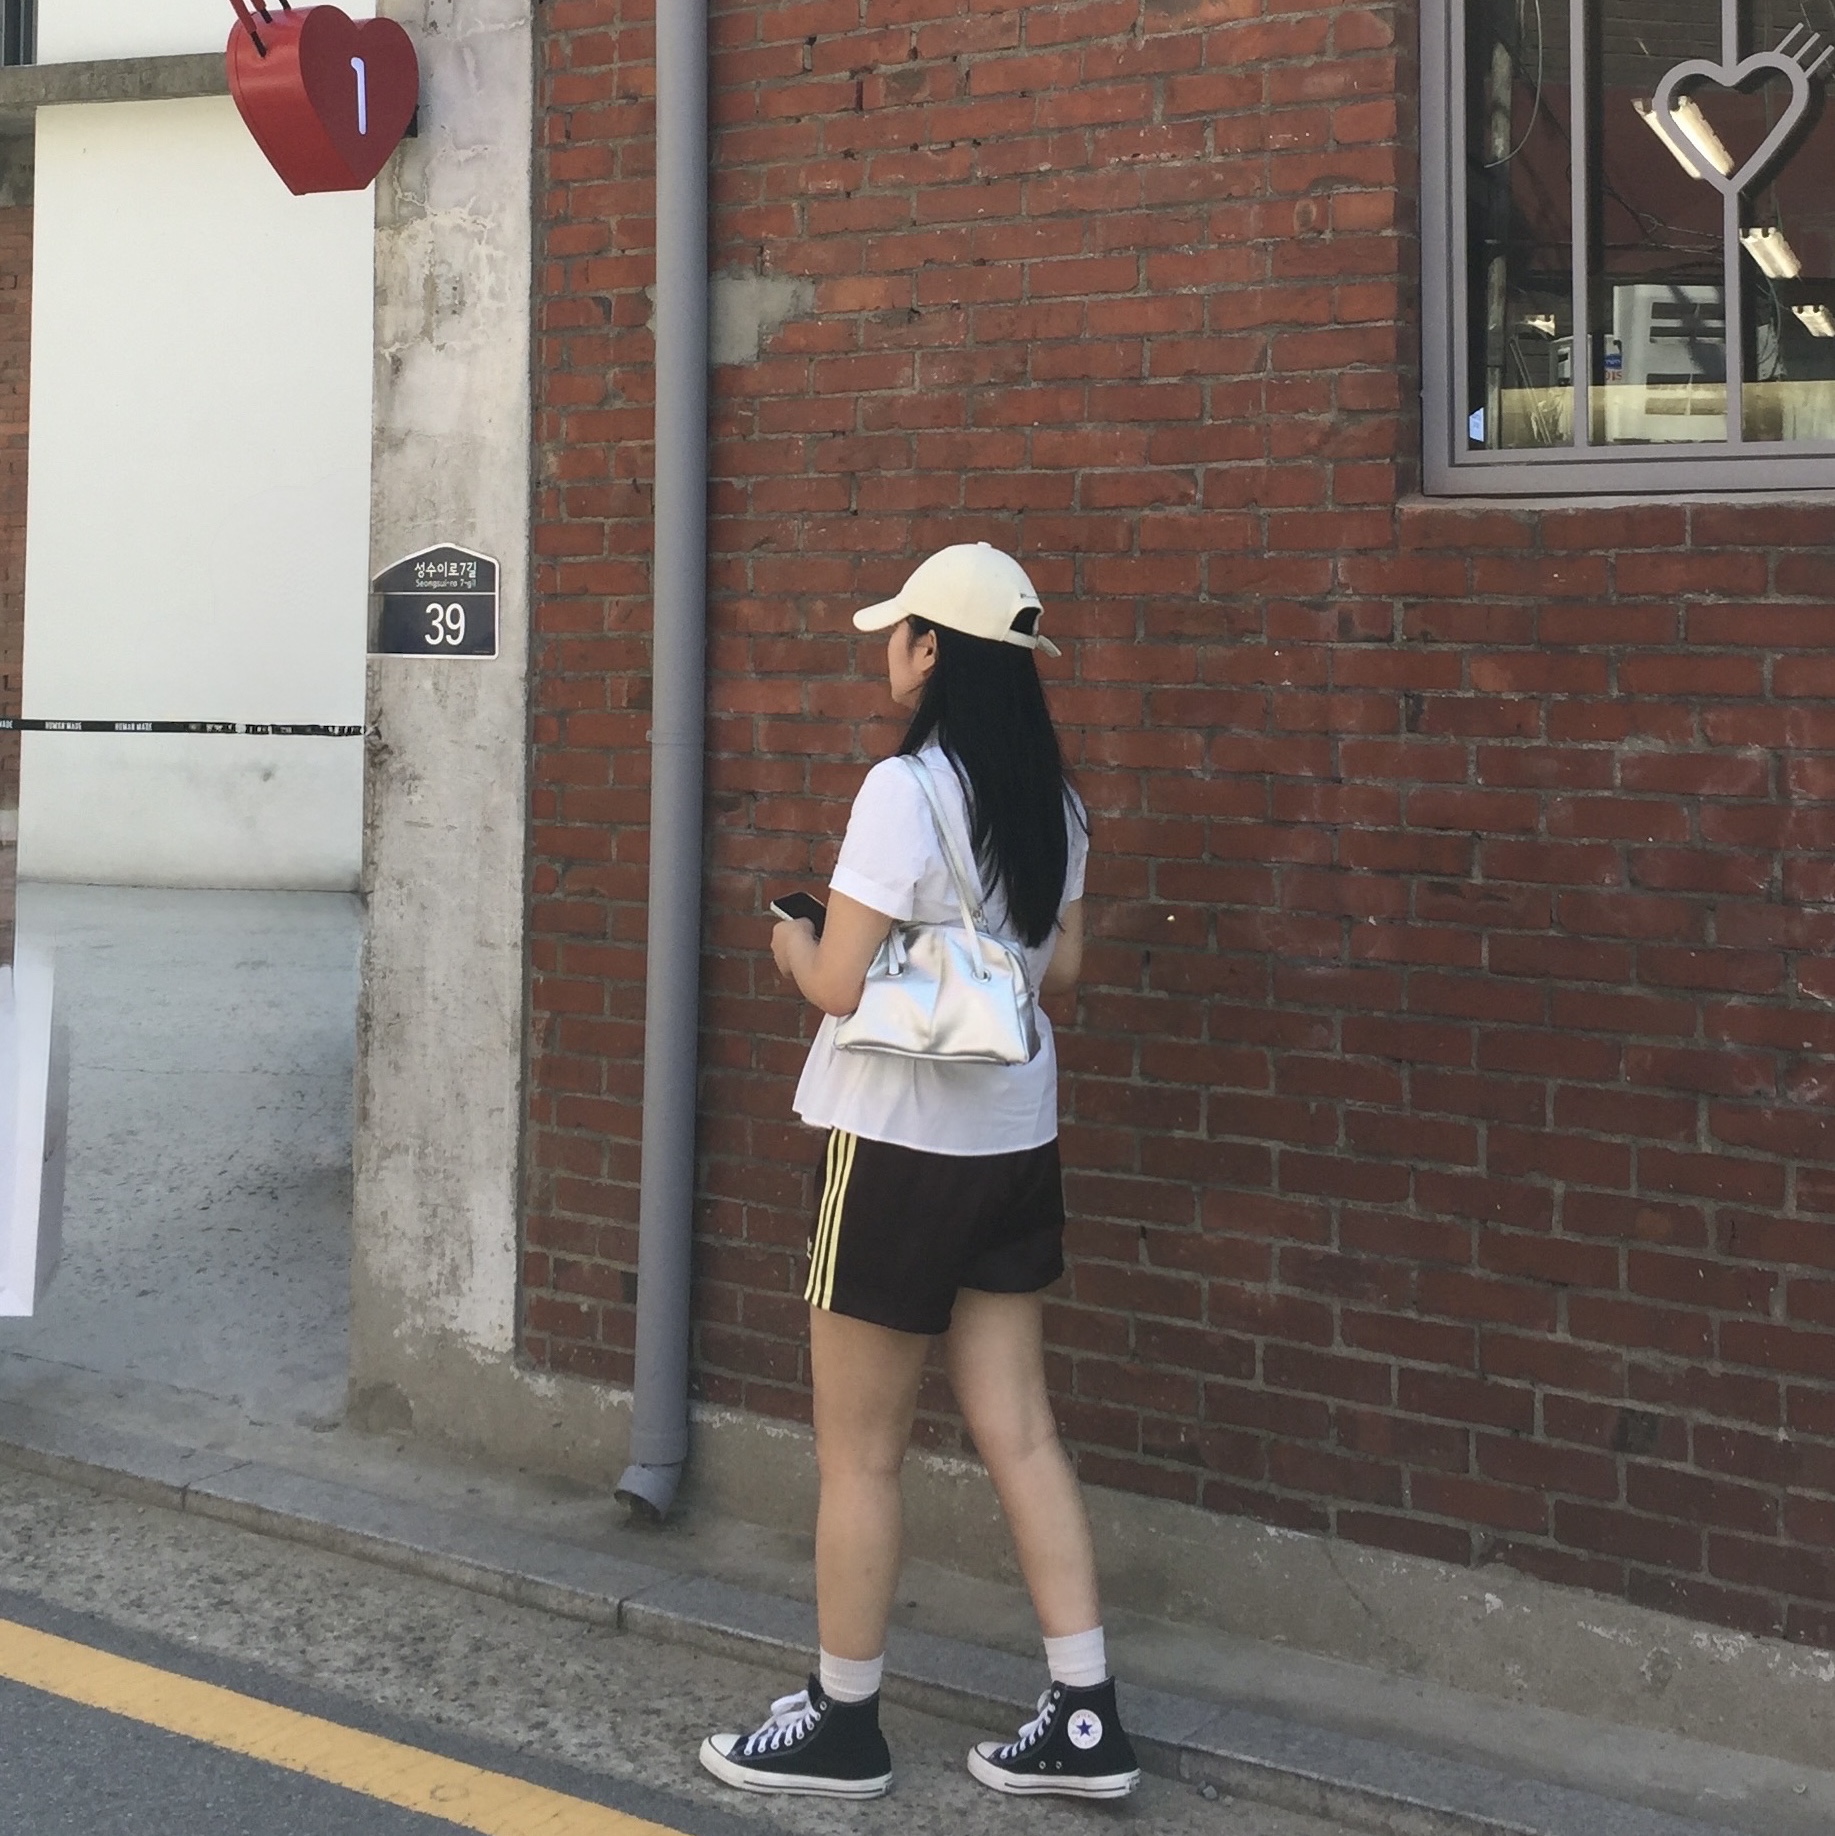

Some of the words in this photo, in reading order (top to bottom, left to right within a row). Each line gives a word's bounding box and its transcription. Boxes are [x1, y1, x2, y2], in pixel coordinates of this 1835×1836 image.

[350, 56, 367, 135] 1
[414, 561, 477, 578] 성수이로7길
[415, 578, 458, 589] Seongsui-ro
[424, 602, 466, 646] 39
